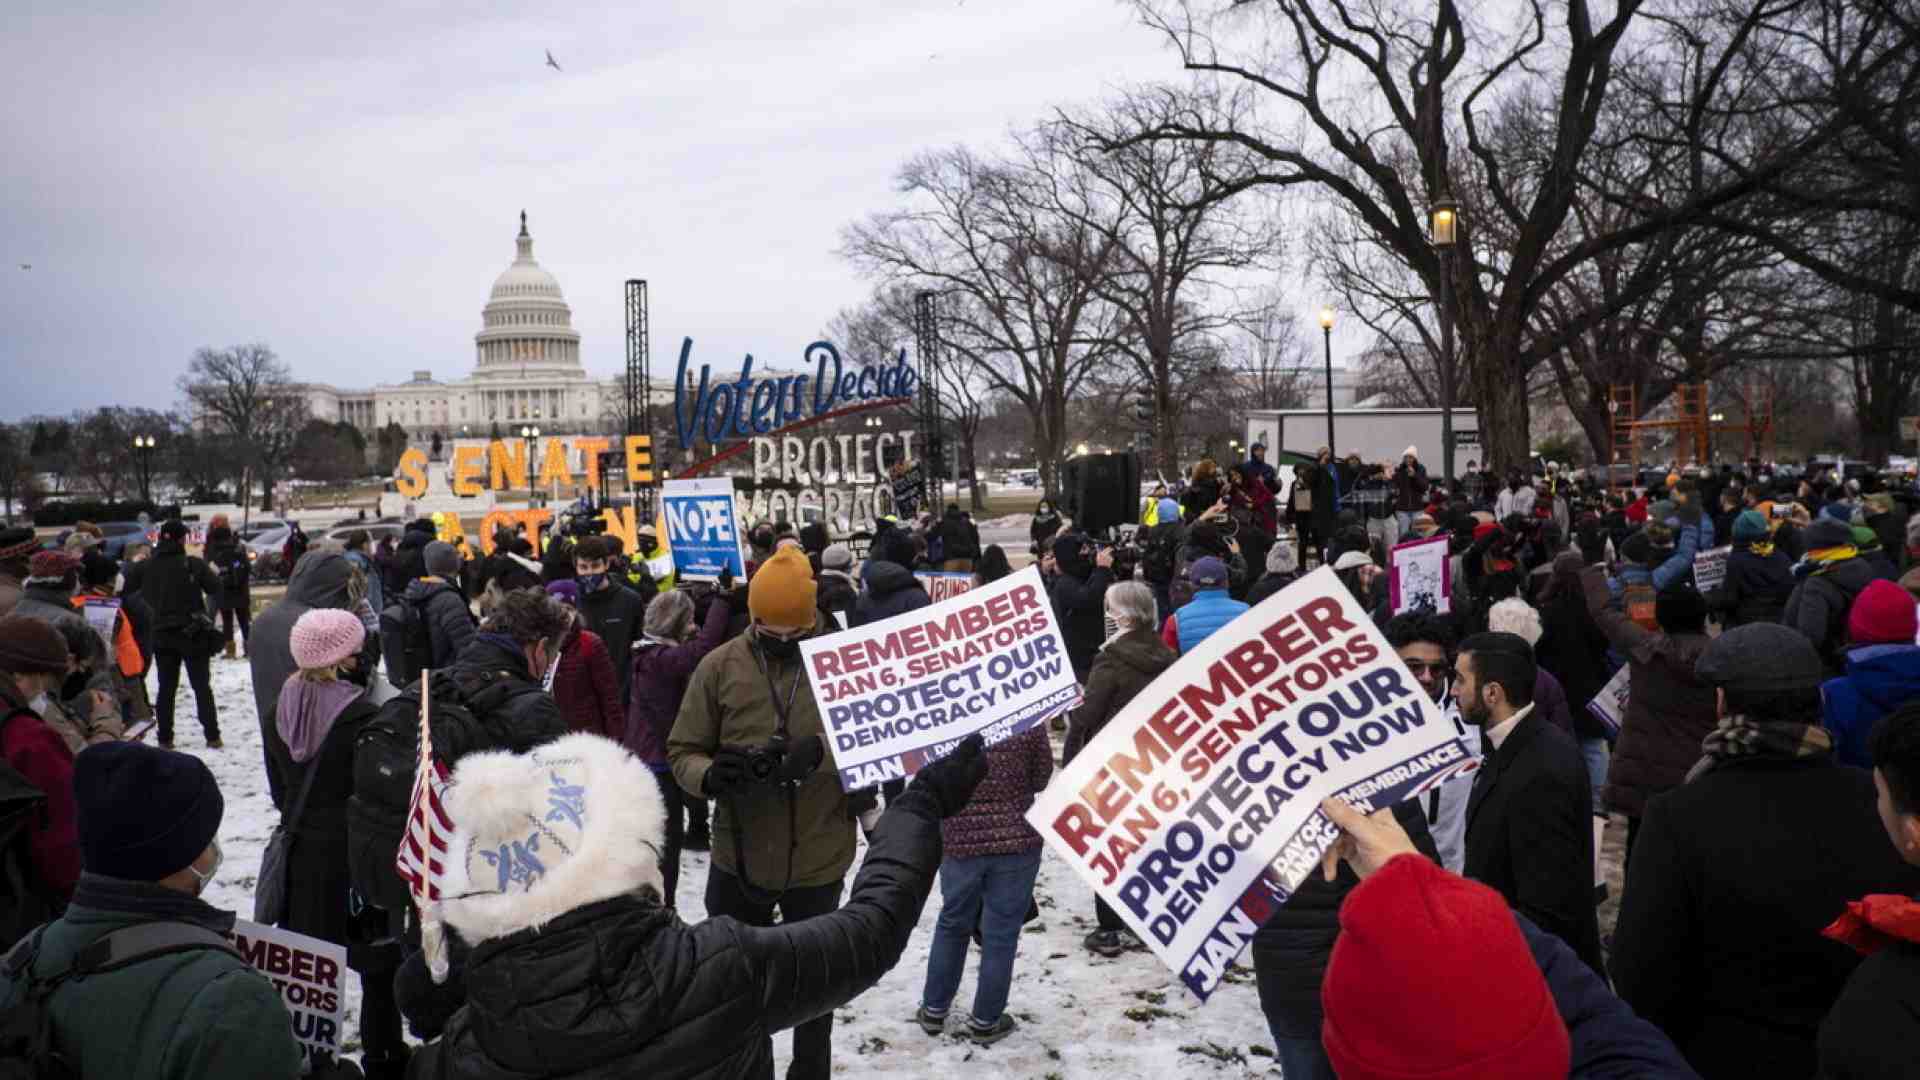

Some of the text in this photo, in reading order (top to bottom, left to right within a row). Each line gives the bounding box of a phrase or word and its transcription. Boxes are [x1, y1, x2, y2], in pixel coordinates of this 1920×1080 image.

[674, 336, 917, 449] Voters Decide
[394, 434, 655, 499] SENATE
[749, 429, 916, 485] PROTECT
[664, 500, 734, 541] NOPE
[811, 583, 1041, 680] REMEMBER
[820, 611, 1049, 703] JAN 6, SENATORS
[827, 633, 1060, 731] PROTECT OUR
[836, 657, 1063, 752] DEMOCRACY NOW
[1051, 596, 1355, 858] REMEMBER
[845, 755, 906, 790] JAN
[1089, 634, 1380, 887] JAN 6, SENATORS
[1118, 667, 1413, 922] PROTECT OUR
[1148, 700, 1426, 947] DEMOCRACY NOW
[1272, 742, 1465, 876] DAY OF MEMBRANCE
[1288, 845, 1320, 890] AND
[228, 932, 339, 989] MBER
[1189, 904, 1260, 993] JAN
[292, 1010, 337, 1047] UR
